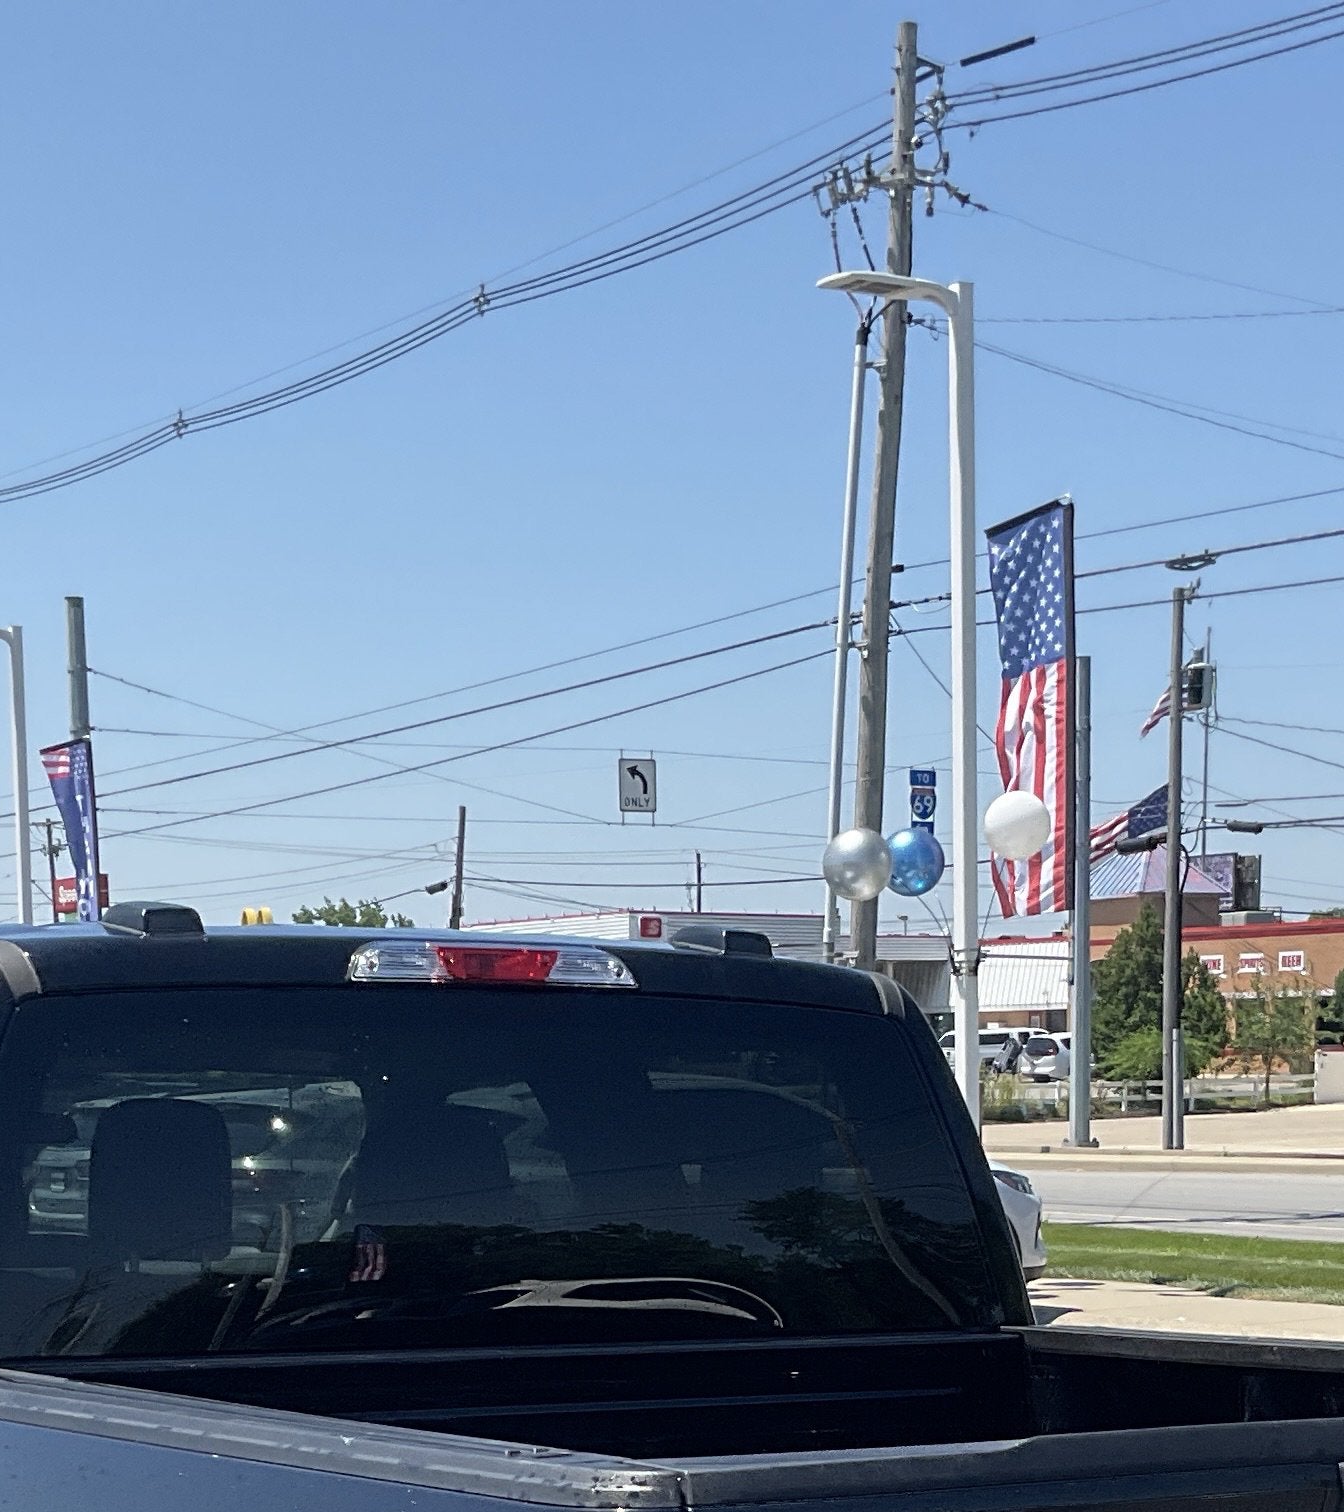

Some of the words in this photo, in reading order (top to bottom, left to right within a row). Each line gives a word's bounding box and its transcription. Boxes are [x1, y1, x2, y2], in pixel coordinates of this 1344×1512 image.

[916, 773, 930, 784] TO
[624, 796, 650, 808] ONLY
[913, 795, 934, 814] 69
